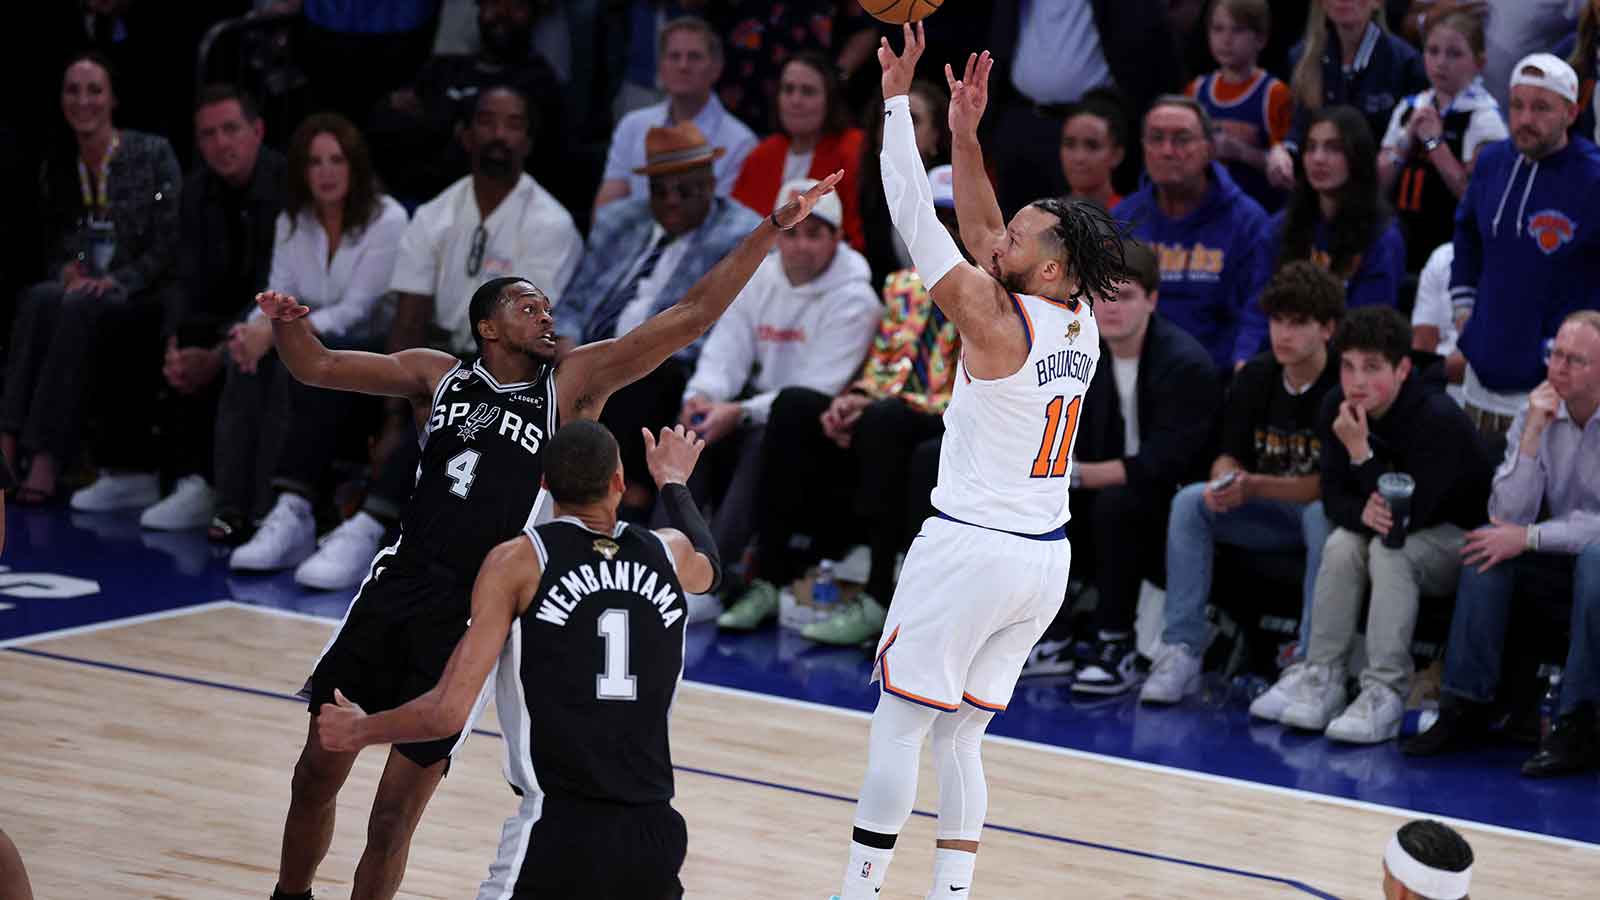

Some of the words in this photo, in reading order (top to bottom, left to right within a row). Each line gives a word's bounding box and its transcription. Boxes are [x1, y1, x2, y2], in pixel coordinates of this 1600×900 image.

[1036, 350, 1093, 387] BRUNSON
[513, 395, 539, 404] LEDGER
[1030, 395, 1081, 478] 11
[444, 448, 481, 500] 4
[535, 560, 683, 628] WEMBANYAMA
[596, 608, 637, 700] 1
